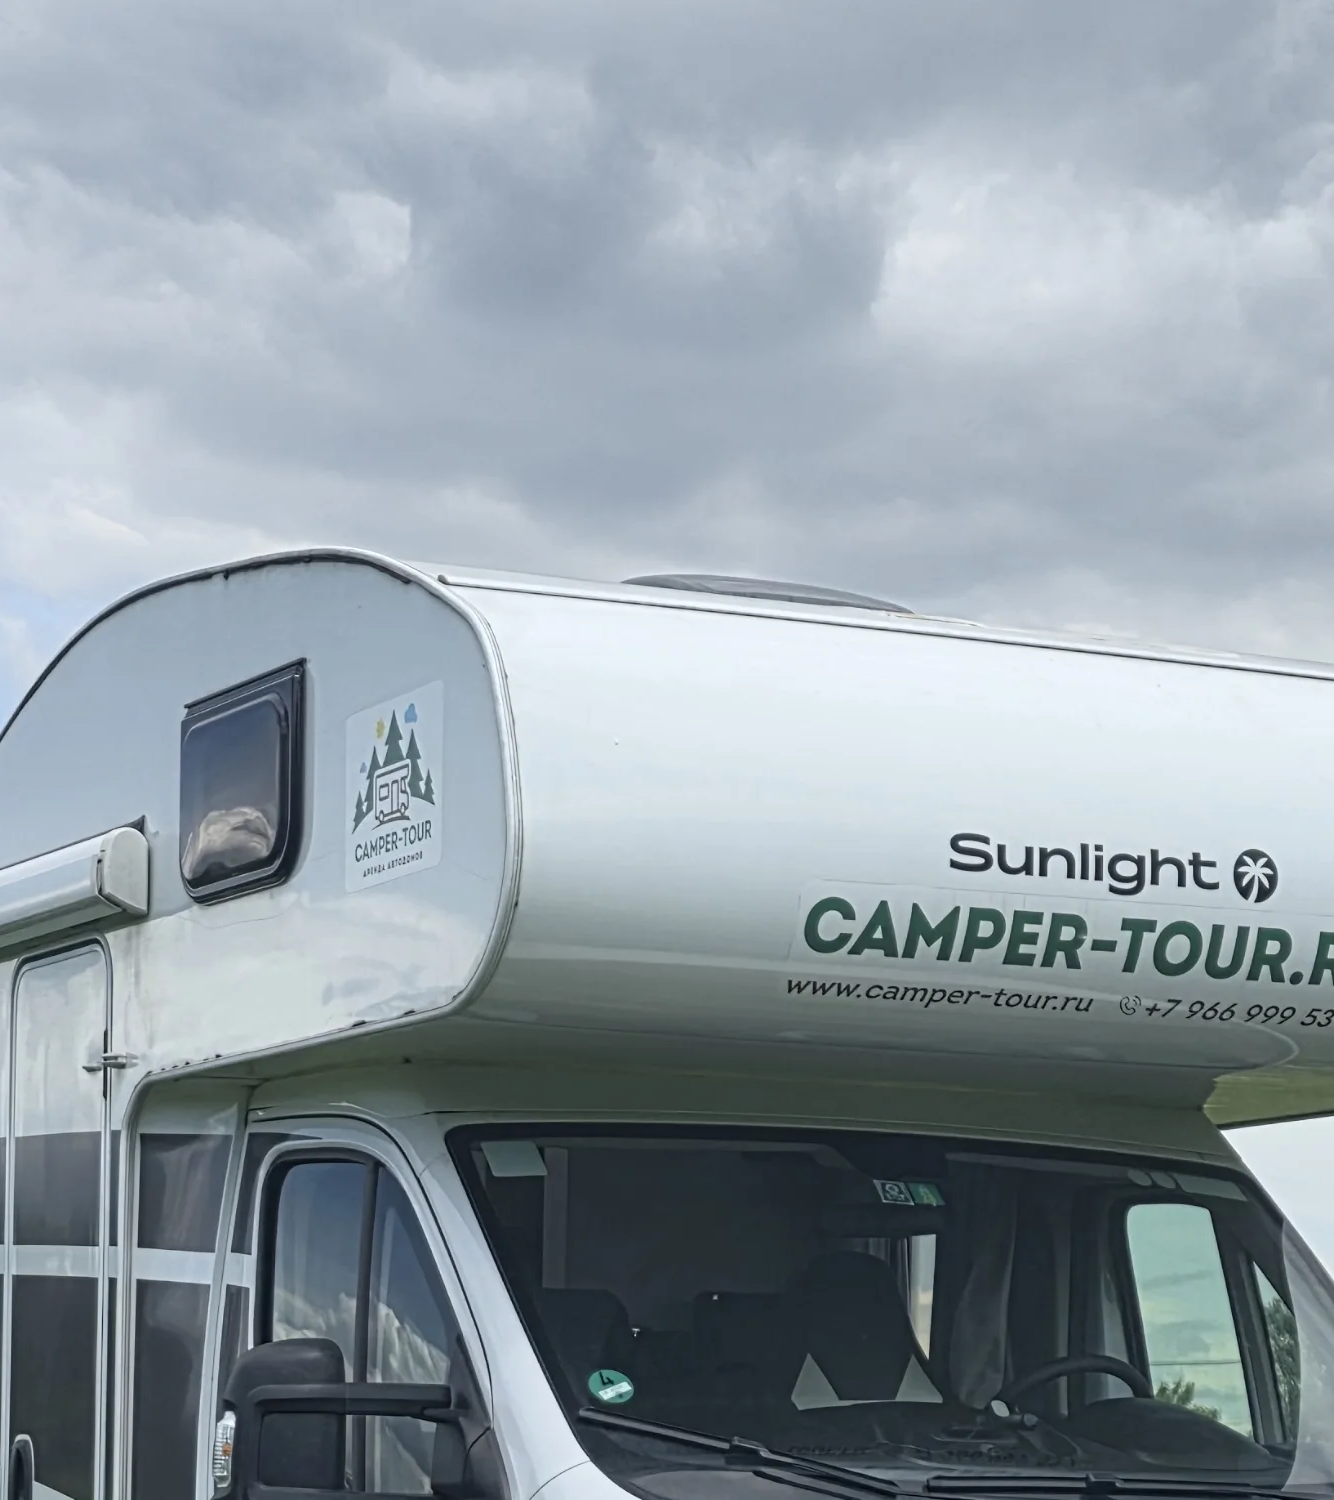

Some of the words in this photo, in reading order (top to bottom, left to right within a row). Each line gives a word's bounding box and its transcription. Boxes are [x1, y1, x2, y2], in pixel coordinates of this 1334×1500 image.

[354, 819, 432, 863] CAMPER-TOUR
[949, 832, 1221, 896] Sunlight
[786, 978, 1094, 1013] www.camper-tour.ru
[1144, 998, 1183, 1018] +7
[1184, 999, 1238, 1022] 966
[1243, 1003, 1297, 1025] 999
